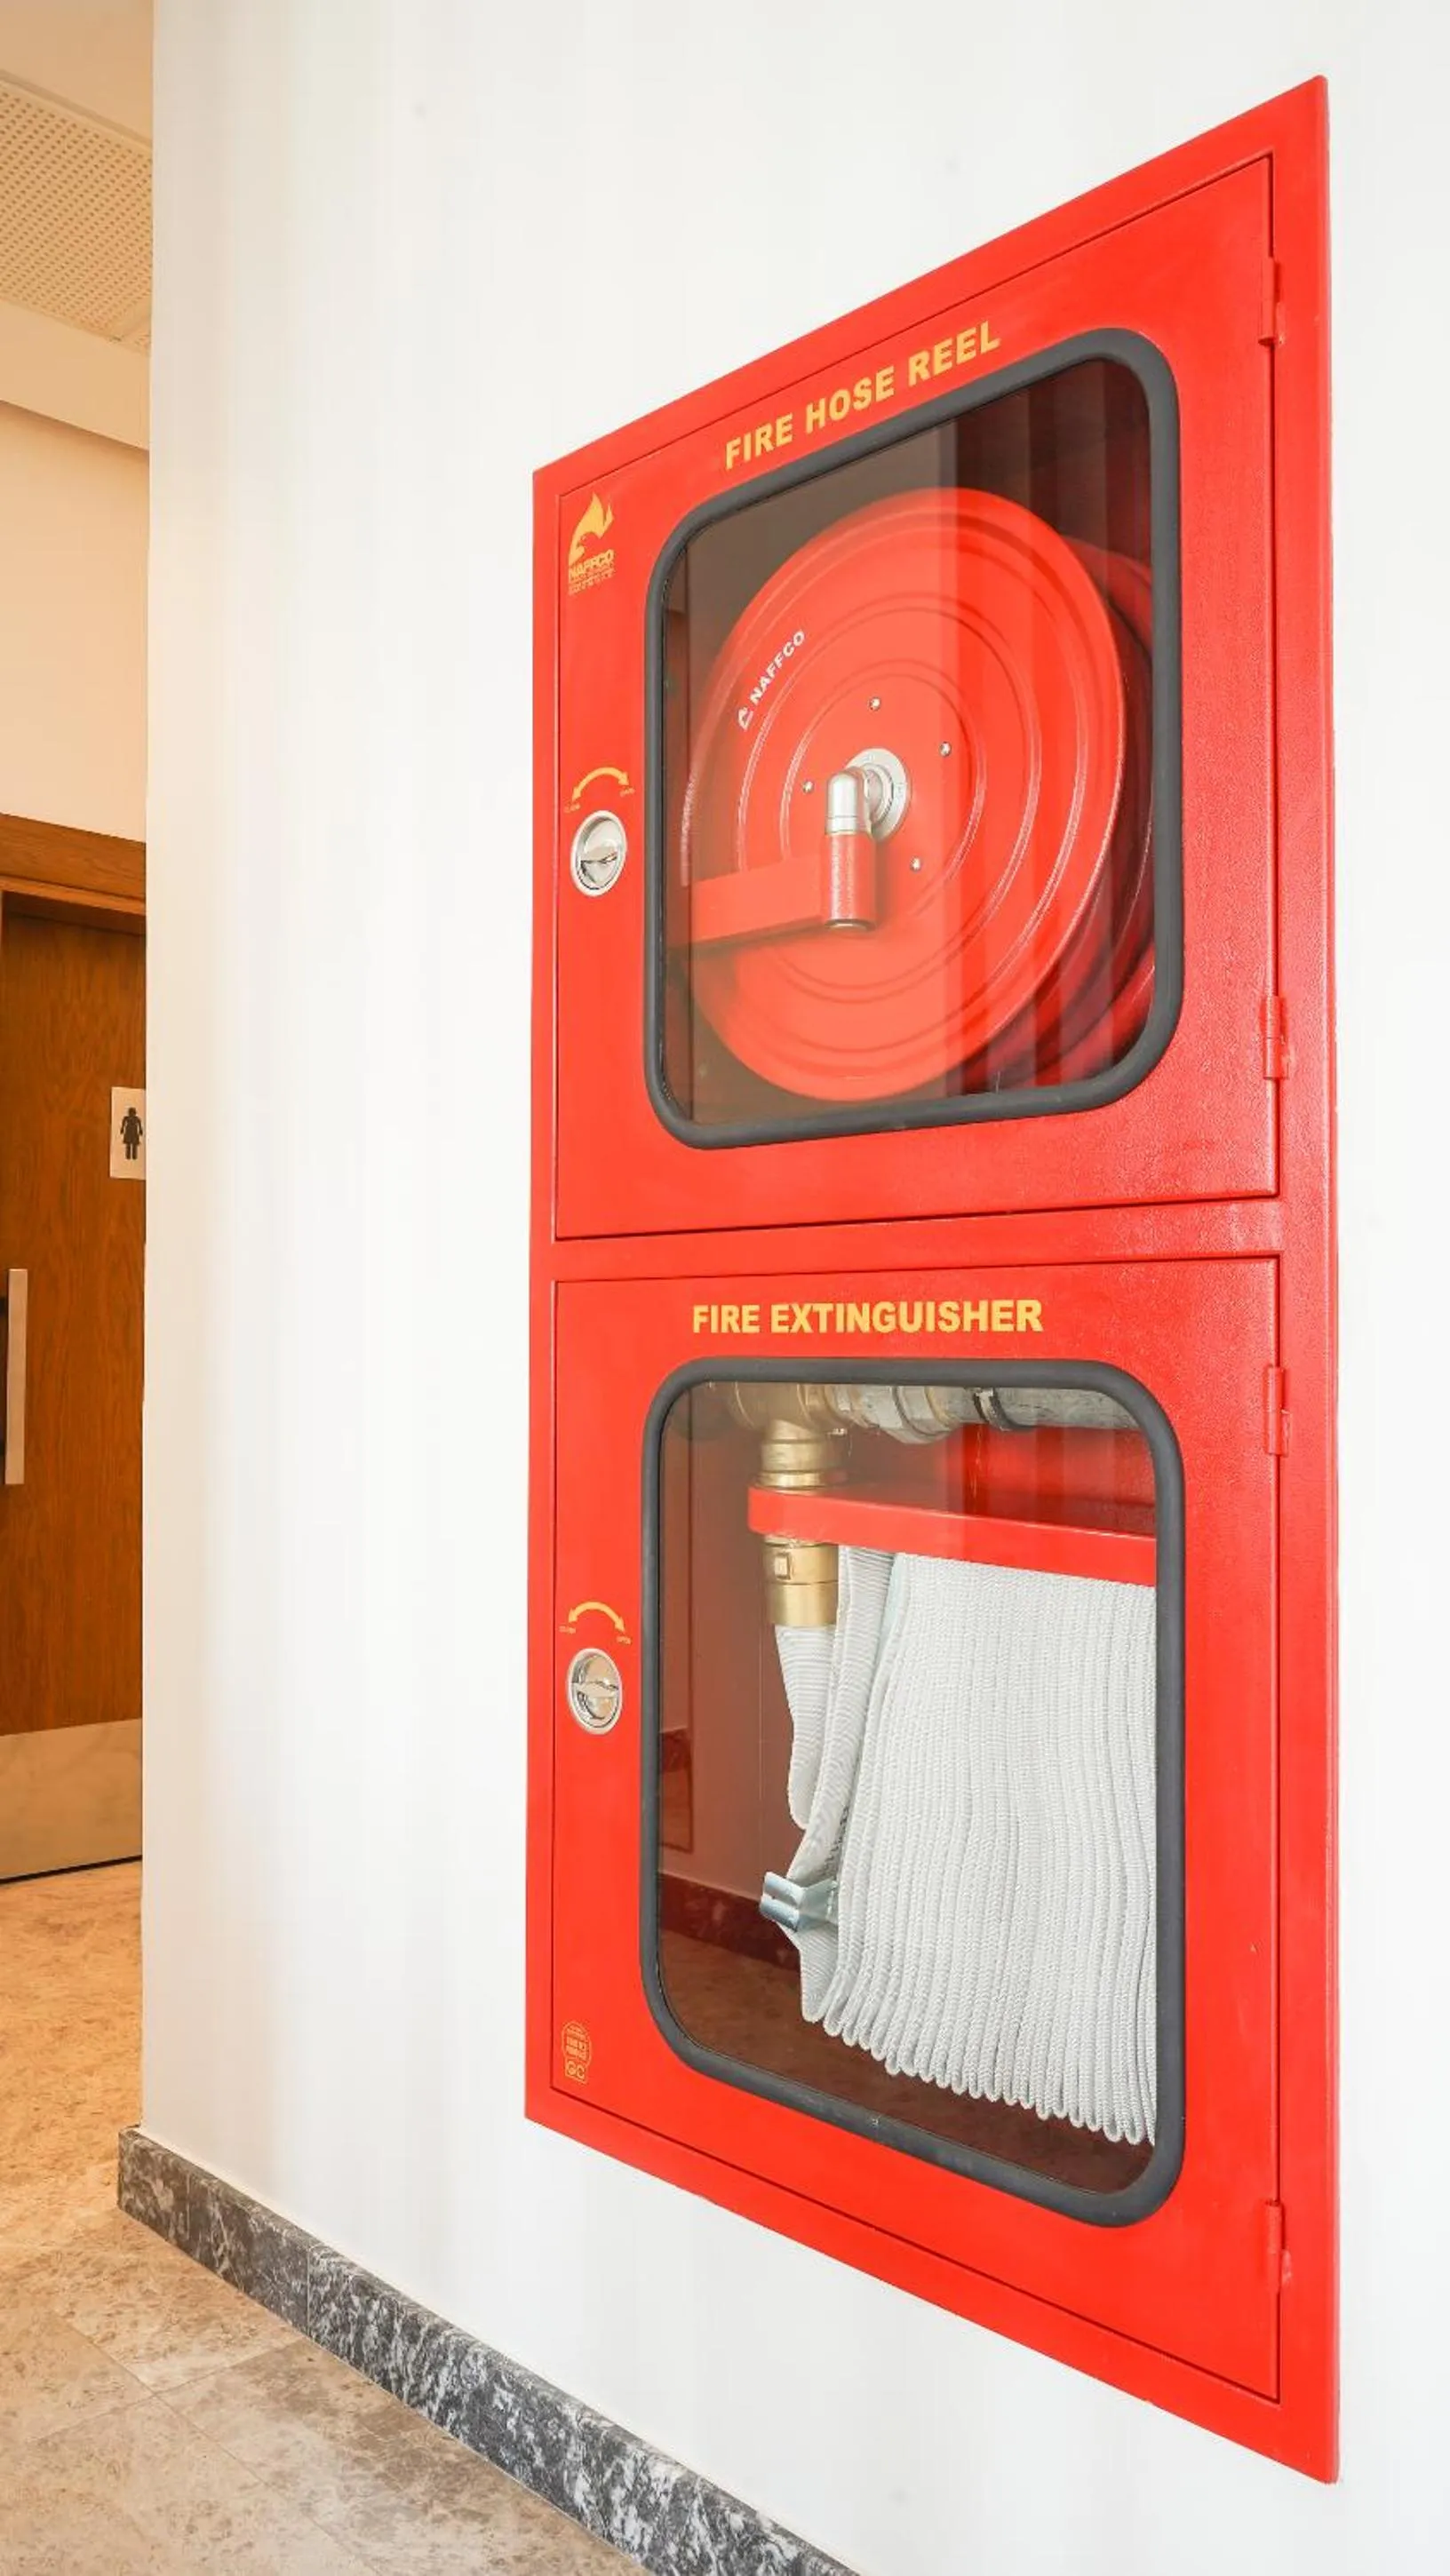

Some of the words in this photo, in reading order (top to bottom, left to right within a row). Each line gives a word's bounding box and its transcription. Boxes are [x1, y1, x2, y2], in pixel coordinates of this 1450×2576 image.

[725, 413, 793, 470] FIRE
[805, 366, 895, 434] HOSE
[908, 321, 1001, 386] REEL
[750, 631, 804, 706] NAFFCO
[691, 1304, 761, 1334] FIRE
[769, 1299, 1044, 1334] EXTINGUISHER
